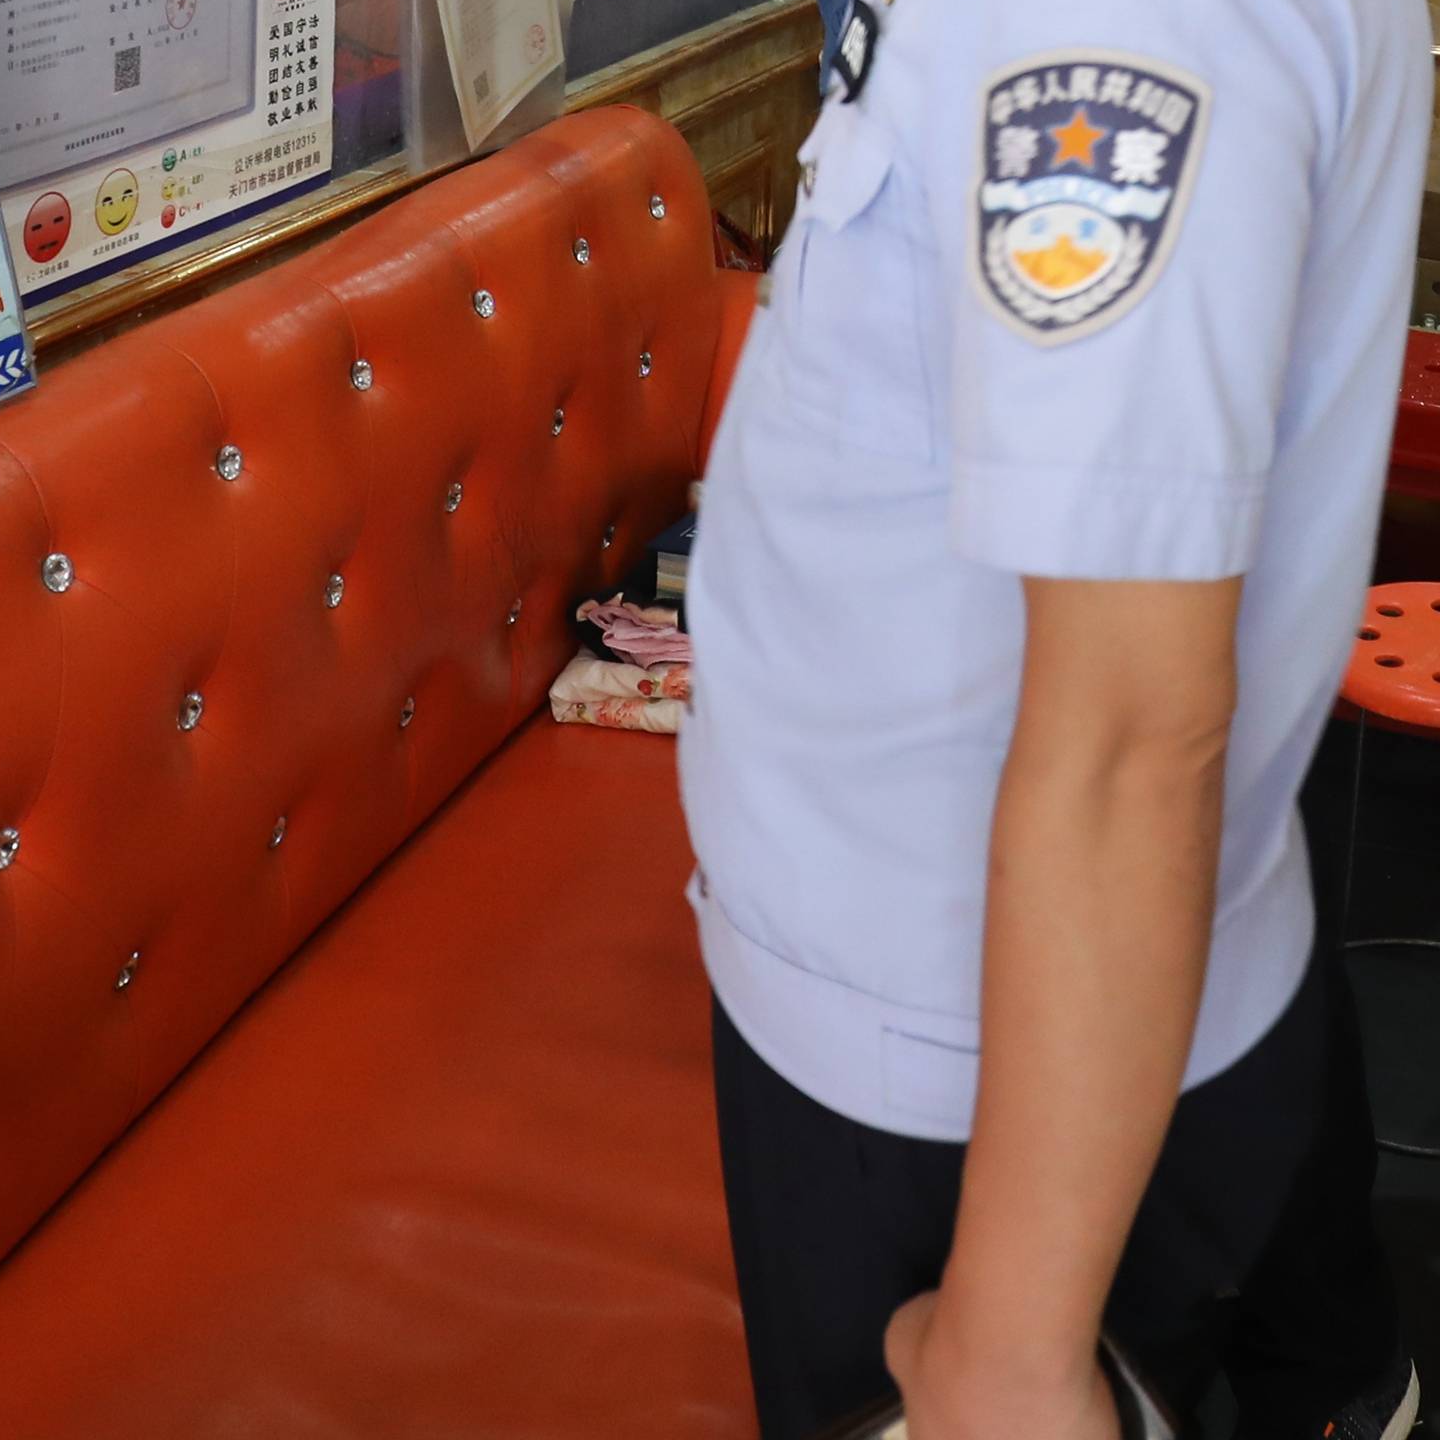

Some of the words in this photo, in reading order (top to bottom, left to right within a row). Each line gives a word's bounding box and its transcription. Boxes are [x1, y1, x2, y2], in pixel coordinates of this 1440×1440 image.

[228, 150, 322, 200] 天门市市场监督管理局
